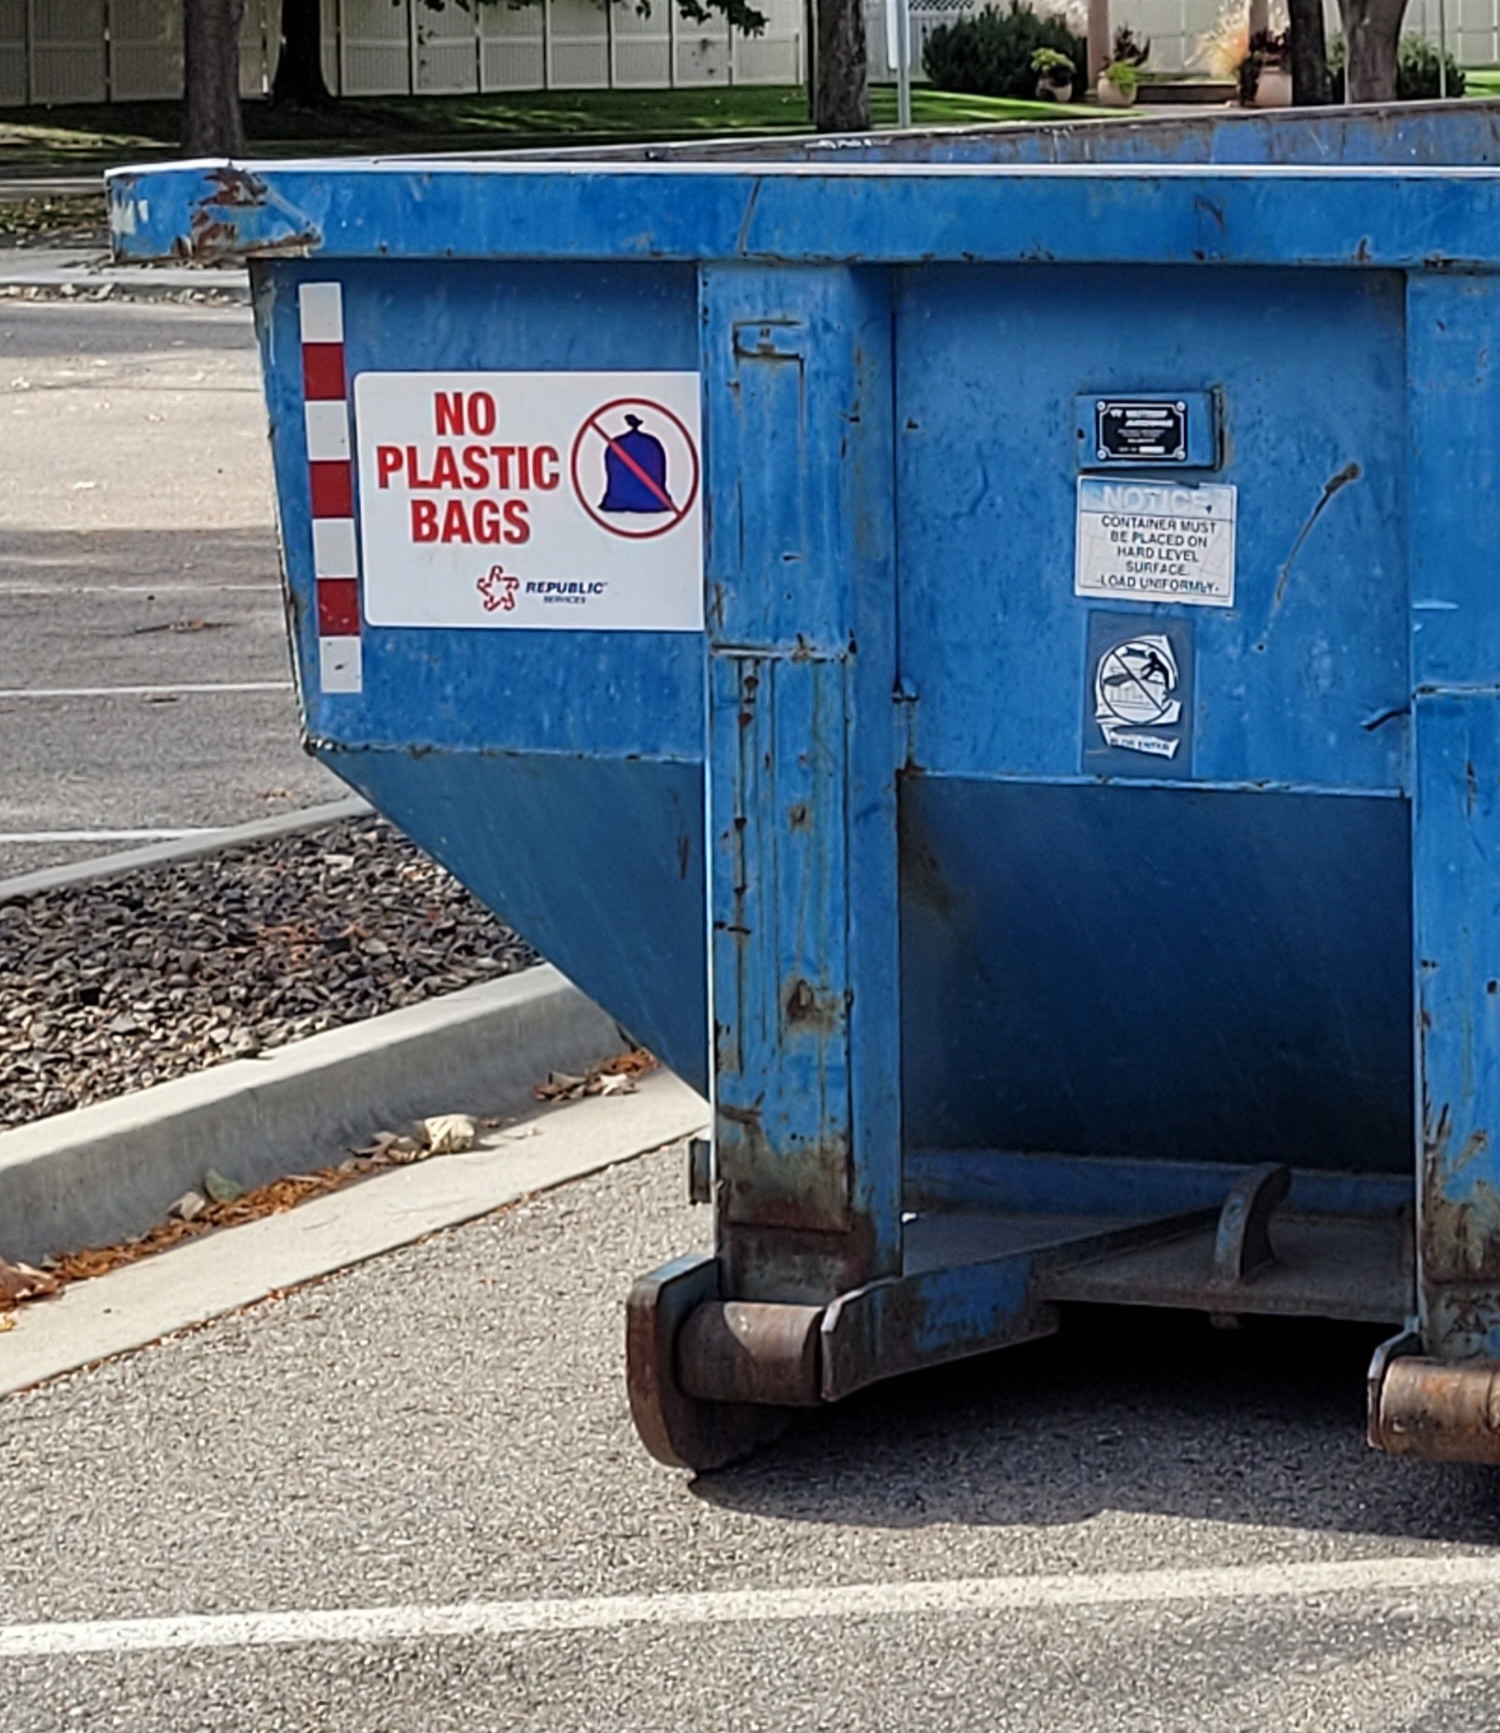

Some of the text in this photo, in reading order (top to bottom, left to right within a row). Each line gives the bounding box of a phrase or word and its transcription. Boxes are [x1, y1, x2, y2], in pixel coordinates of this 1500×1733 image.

[434, 391, 496, 436] NO
[376, 445, 560, 491] PLASTIC
[1102, 485, 1210, 513] NOTICE
[411, 499, 531, 545] BAGS
[1101, 515, 1217, 534] CONTAINER MUST
[1111, 530, 1208, 548] BE PLACED ON
[1117, 546, 1199, 563] HARD LEVEL
[525, 581, 604, 595] REPUBLIC
[543, 595, 587, 605] SERVICES
